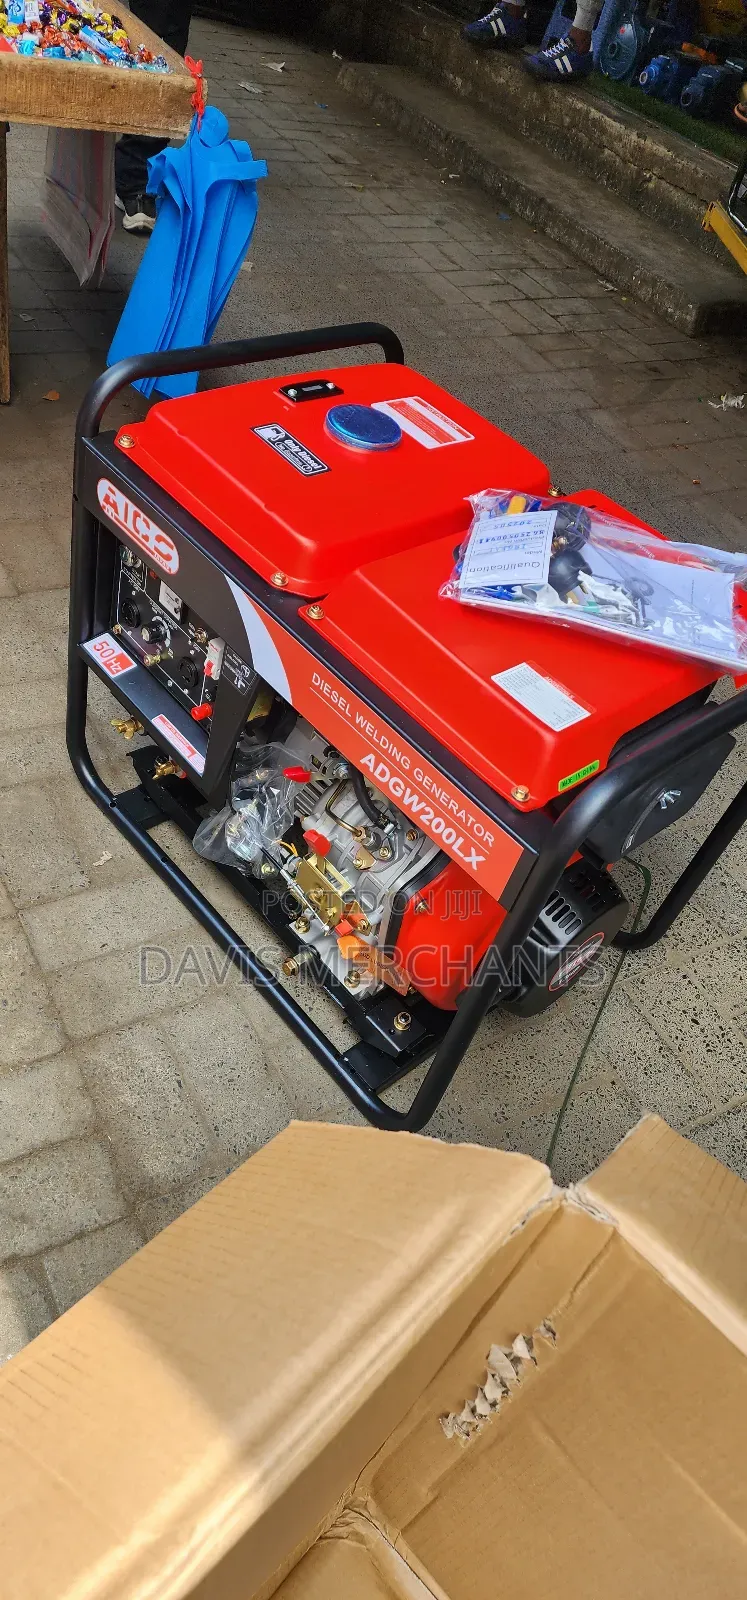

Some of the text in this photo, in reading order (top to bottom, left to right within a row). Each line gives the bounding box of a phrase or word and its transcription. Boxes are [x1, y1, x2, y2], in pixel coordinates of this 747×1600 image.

[297, 451, 323, 469] Diesel
[469, 561, 541, 573] Qualification
[93, 640, 122, 673] 50Hz
[312, 672, 495, 847] DIESEL WELDING GENERATOR
[360, 753, 486, 871] ADGW200LX
